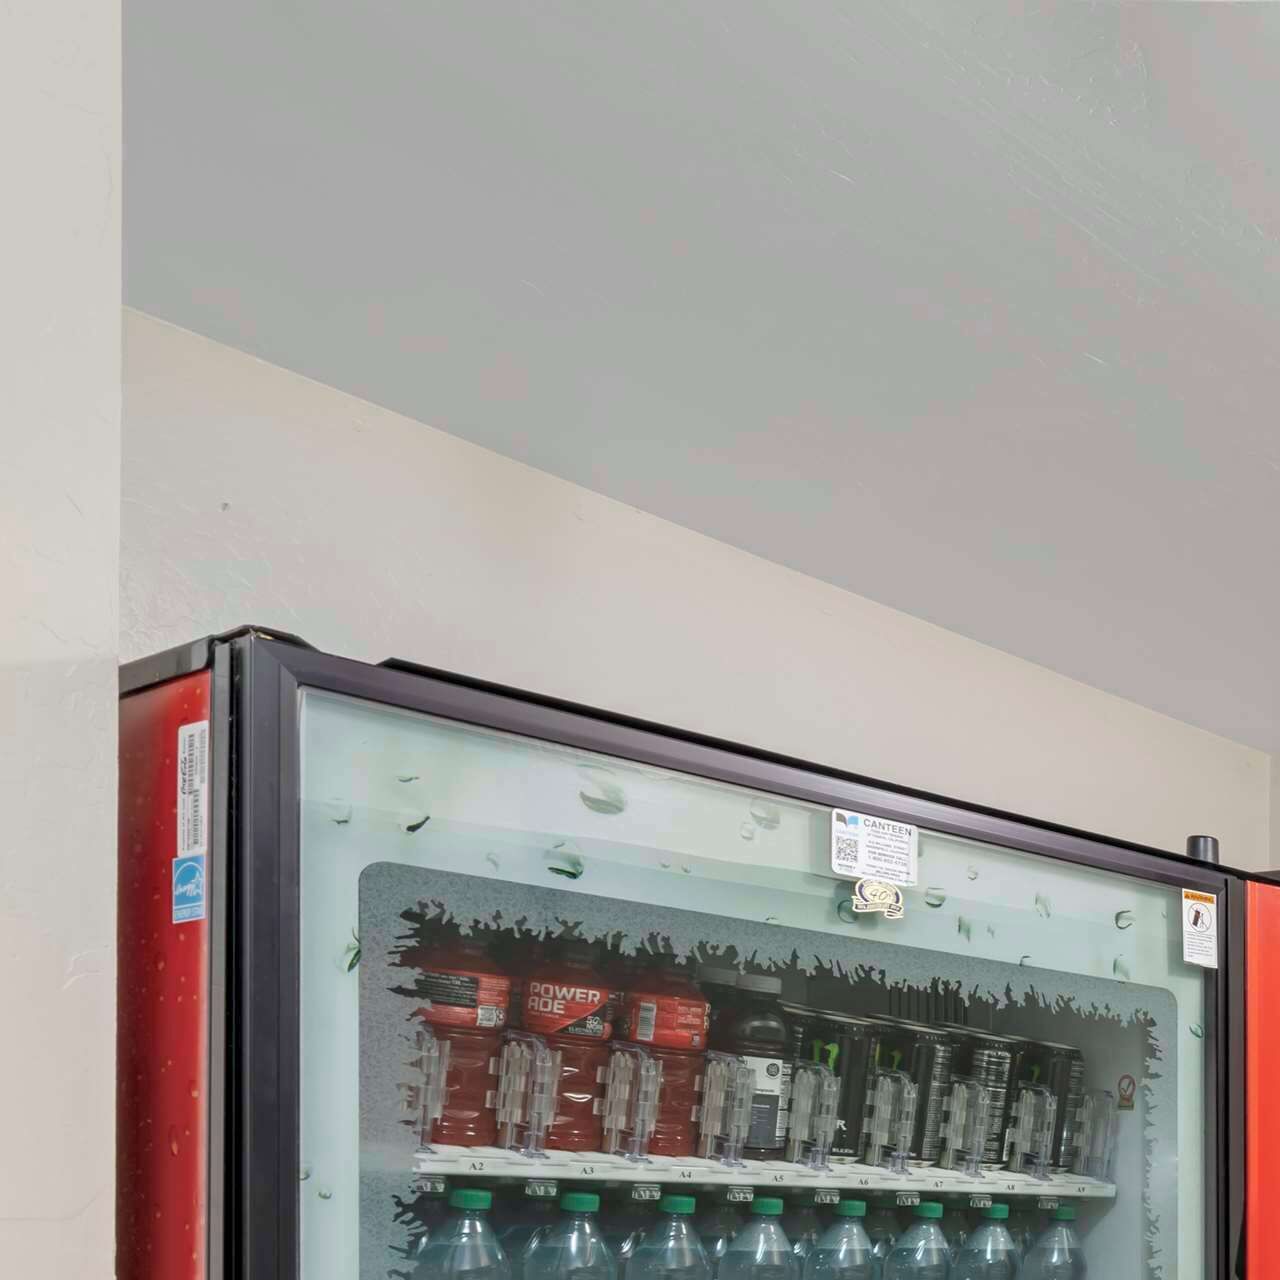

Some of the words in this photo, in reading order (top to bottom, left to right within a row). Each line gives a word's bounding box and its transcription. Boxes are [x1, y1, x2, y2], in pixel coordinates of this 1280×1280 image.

[863, 818, 912, 837] CANTEEN
[530, 982, 601, 1004] POWER
[528, 996, 566, 1014] ADE
[469, 1161, 485, 1171] A2
[581, 1166, 595, 1176] A3
[679, 1170, 693, 1179] A4
[773, 1174, 786, 1183] A5
[858, 1178, 870, 1187] A6
[933, 1180, 944, 1188] A7
